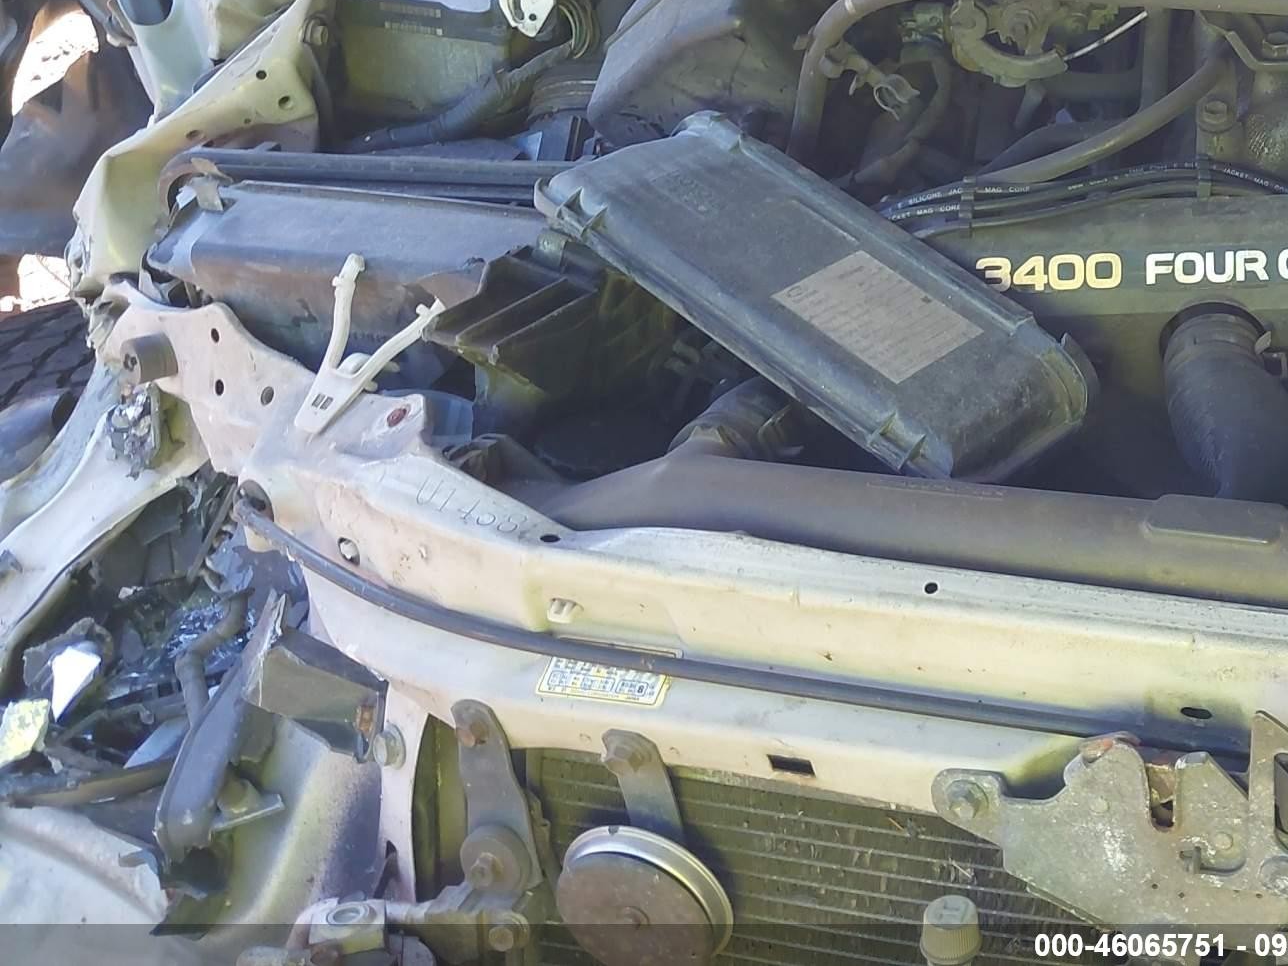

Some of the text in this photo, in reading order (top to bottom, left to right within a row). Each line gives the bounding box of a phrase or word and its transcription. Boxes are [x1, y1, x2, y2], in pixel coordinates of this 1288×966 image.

[916, 207, 934, 216] MAG
[975, 251, 1123, 293] 3400
[1145, 248, 1270, 286] FOUR
